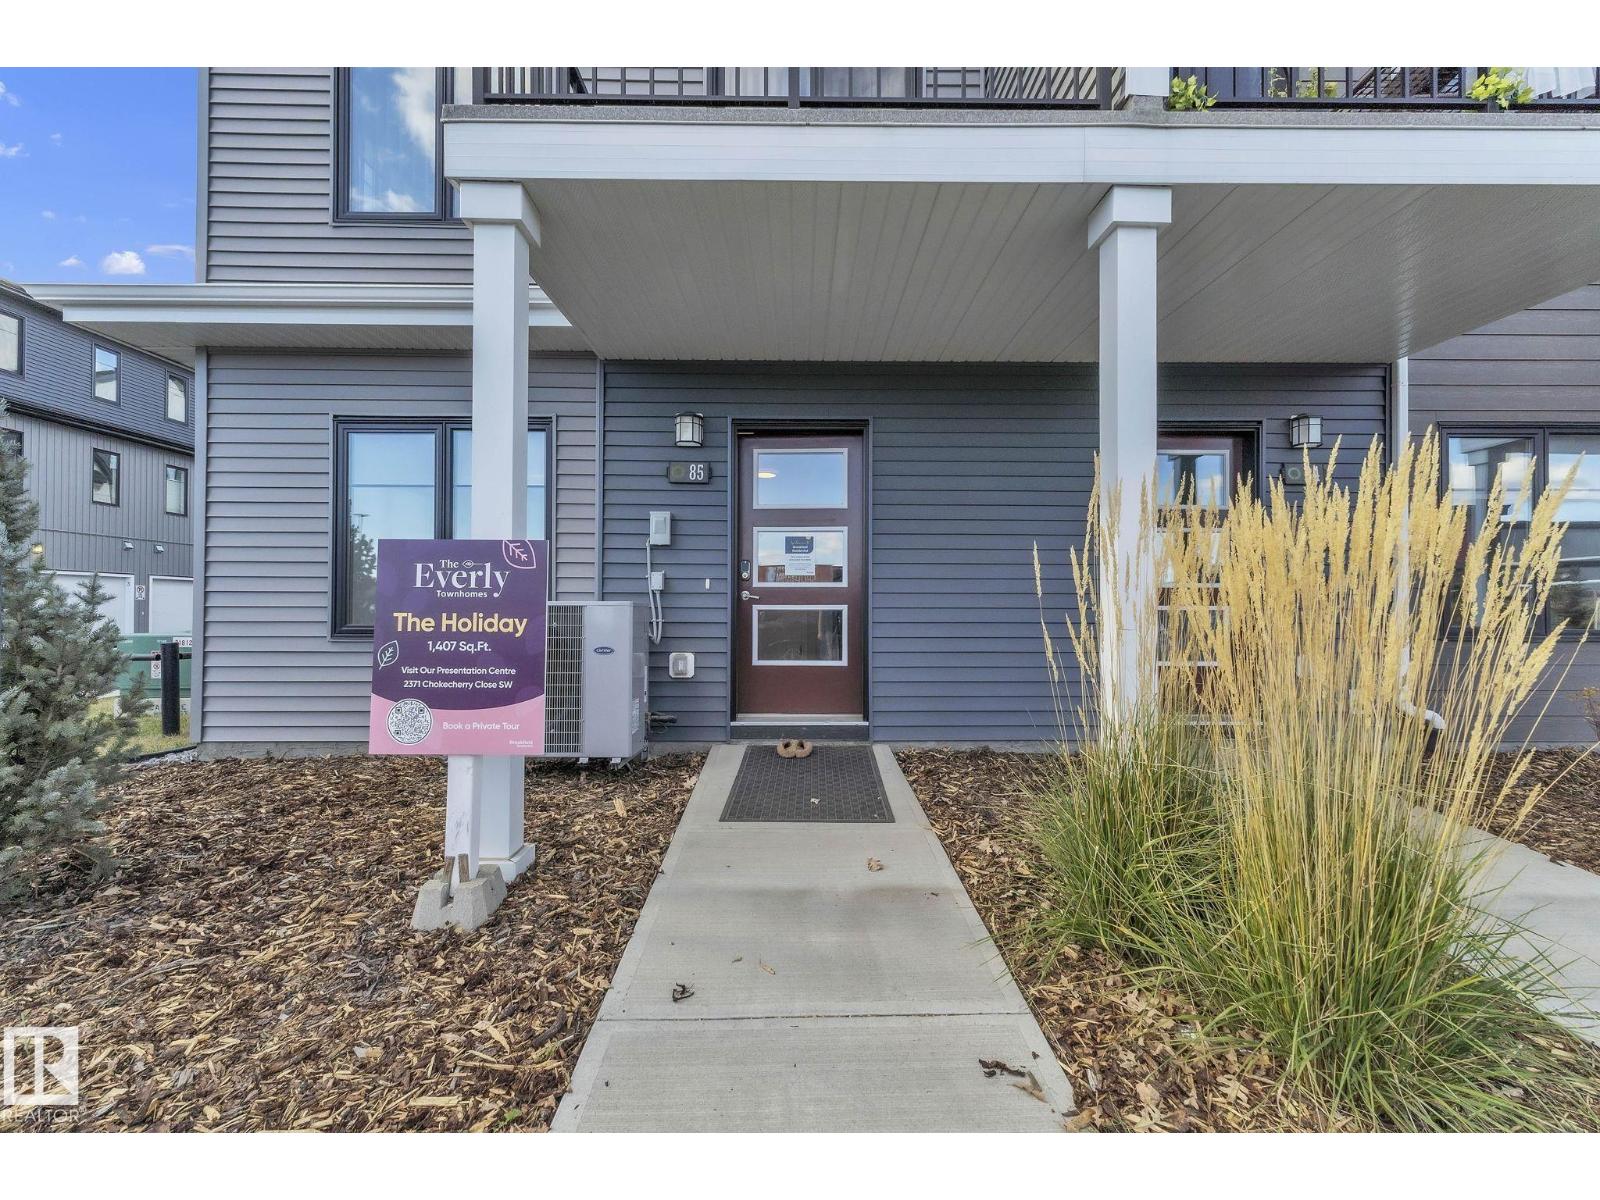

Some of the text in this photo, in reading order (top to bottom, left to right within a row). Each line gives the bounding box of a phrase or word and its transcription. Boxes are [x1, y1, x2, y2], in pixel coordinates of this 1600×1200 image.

[689, 464, 704, 480] 85
[440, 559, 459, 569] The
[412, 562, 511, 598] Everly
[436, 590, 488, 598] Townhomes
[393, 612, 528, 637] The Holiday
[427, 641, 492, 654] 1,407 Sq.Ft.
[401, 666, 516, 675] Visit Our Presentation Centre
[403, 680, 513, 690] 2371 Chokecherry Close SW
[442, 721, 464, 730] Book
[472, 721, 501, 730] Private
[502, 722, 520, 730] Tour
